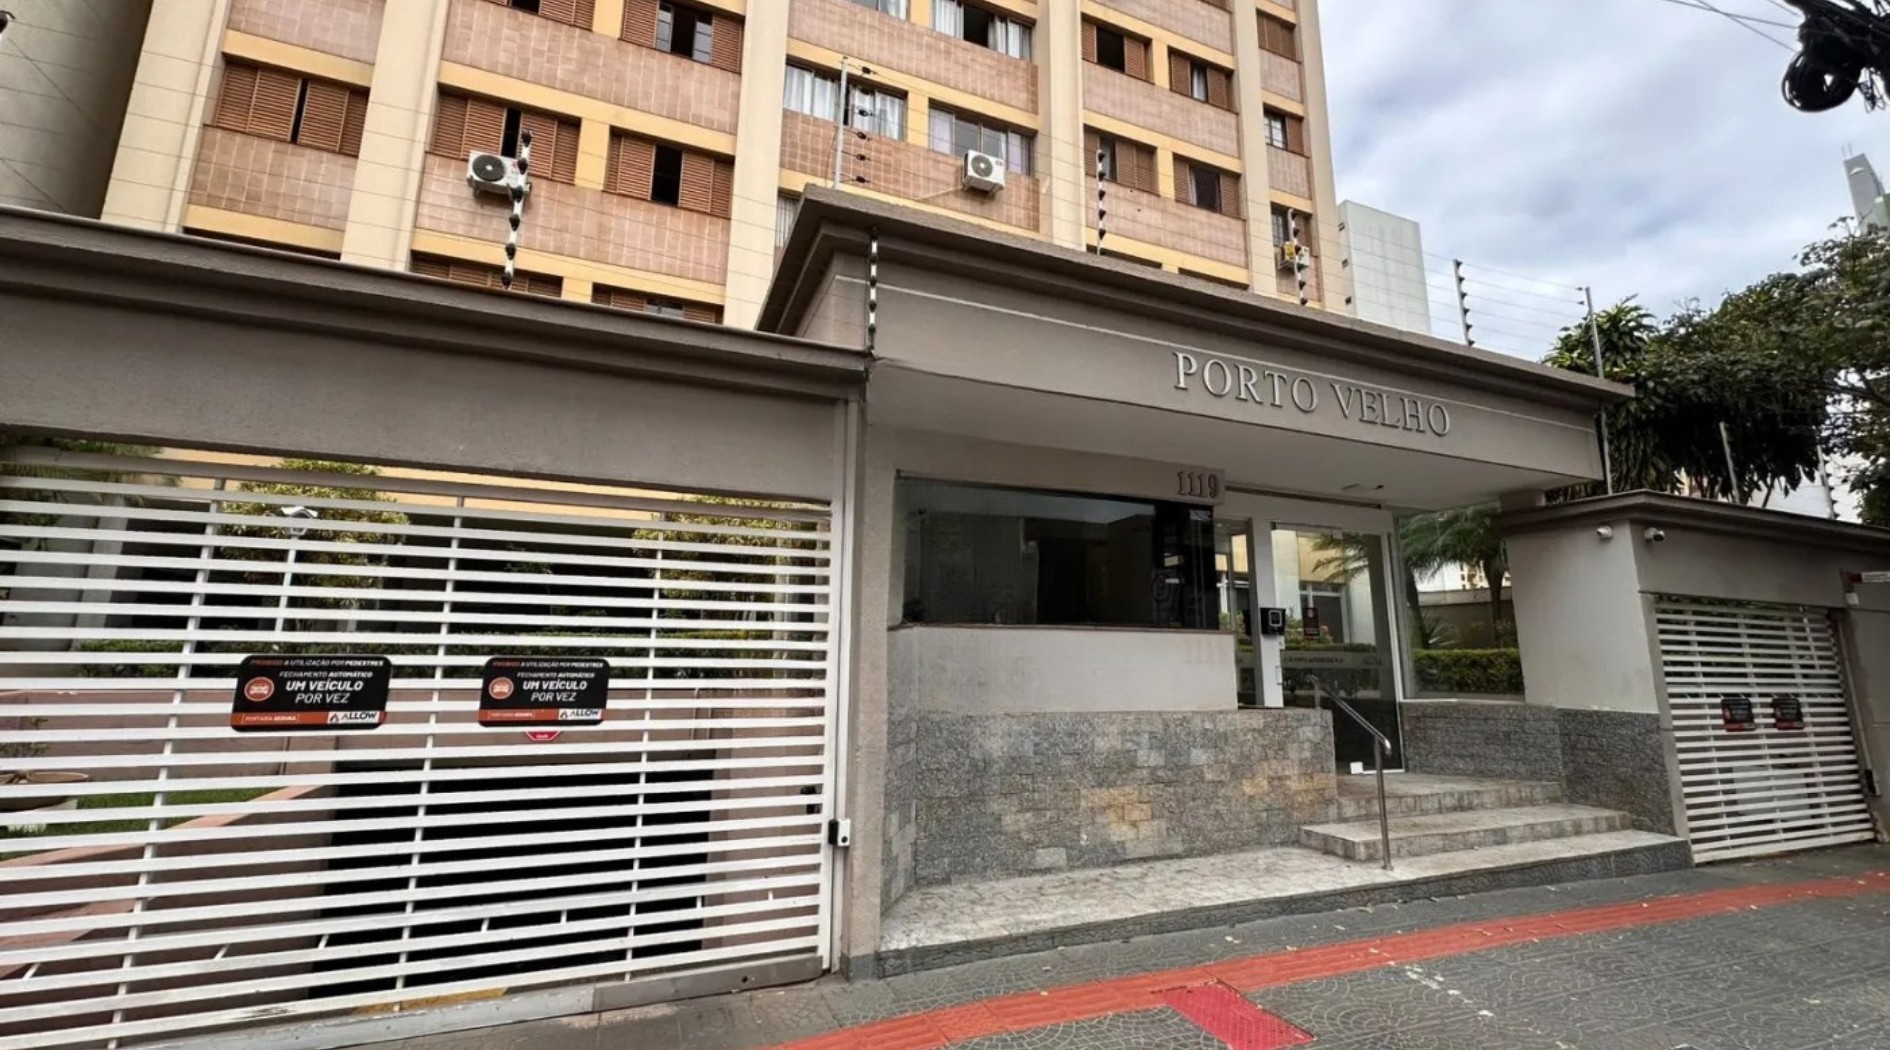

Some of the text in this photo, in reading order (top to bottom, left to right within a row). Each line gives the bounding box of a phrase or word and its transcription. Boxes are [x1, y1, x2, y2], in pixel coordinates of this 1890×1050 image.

[1173, 351, 1450, 437] PORTO VELHO
[1177, 470, 1220, 499] 1119
[285, 678, 364, 691] UM VEÍCULO
[522, 679, 588, 690] UM VEÍCULO
[295, 692, 351, 704] POR VEZ
[531, 692, 577, 702] POR VEZ
[340, 711, 377, 720] ALLOW
[570, 710, 599, 718] ALLOW
